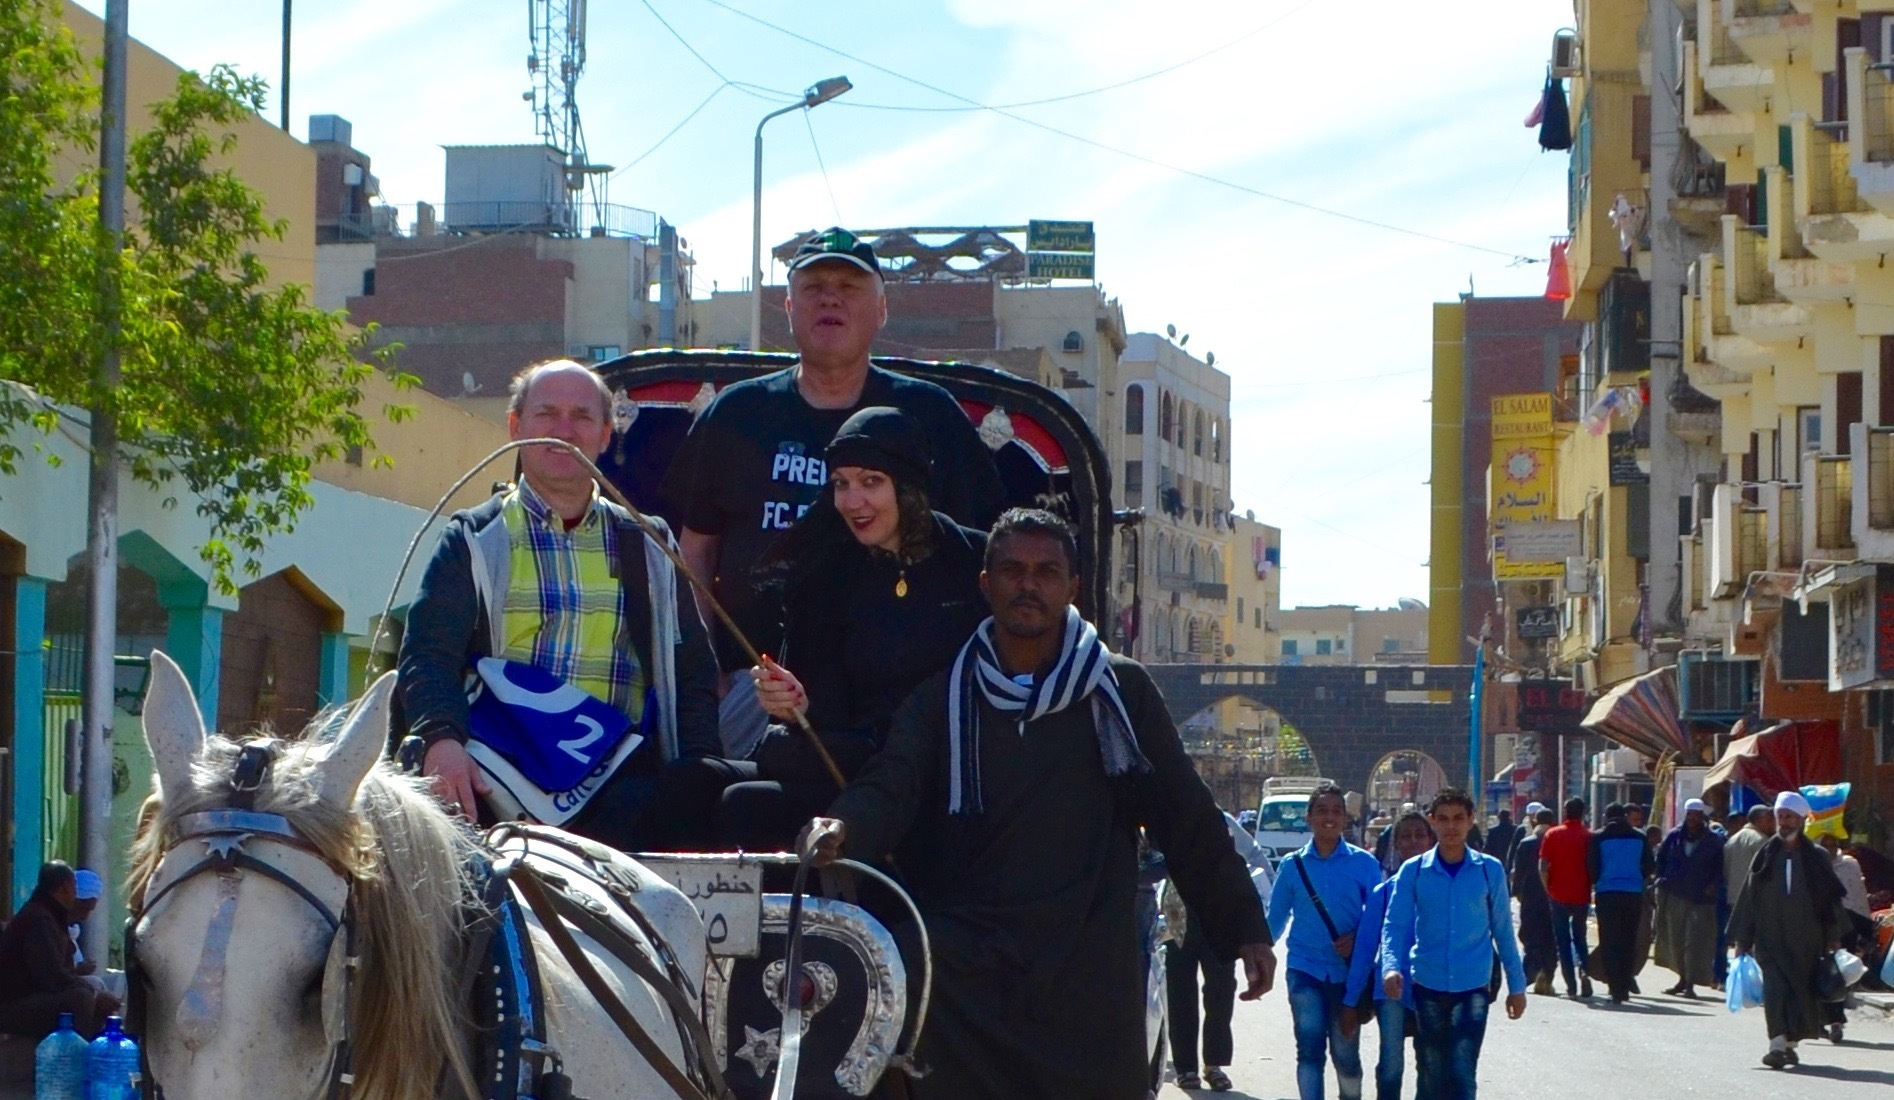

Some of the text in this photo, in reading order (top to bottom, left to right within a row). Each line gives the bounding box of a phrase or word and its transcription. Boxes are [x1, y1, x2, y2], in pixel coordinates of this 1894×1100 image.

[1030, 255, 1091, 265] PARADISE
[1037, 267, 1082, 277] HOTEL
[1494, 397, 1548, 414] EL SALAM
[1495, 421, 1549, 434] RESTAURANT
[1497, 491, 1546, 508] السلام
[762, 501, 790, 529] FC
[556, 714, 604, 765] 2
[687, 873, 754, 899] حنطور
